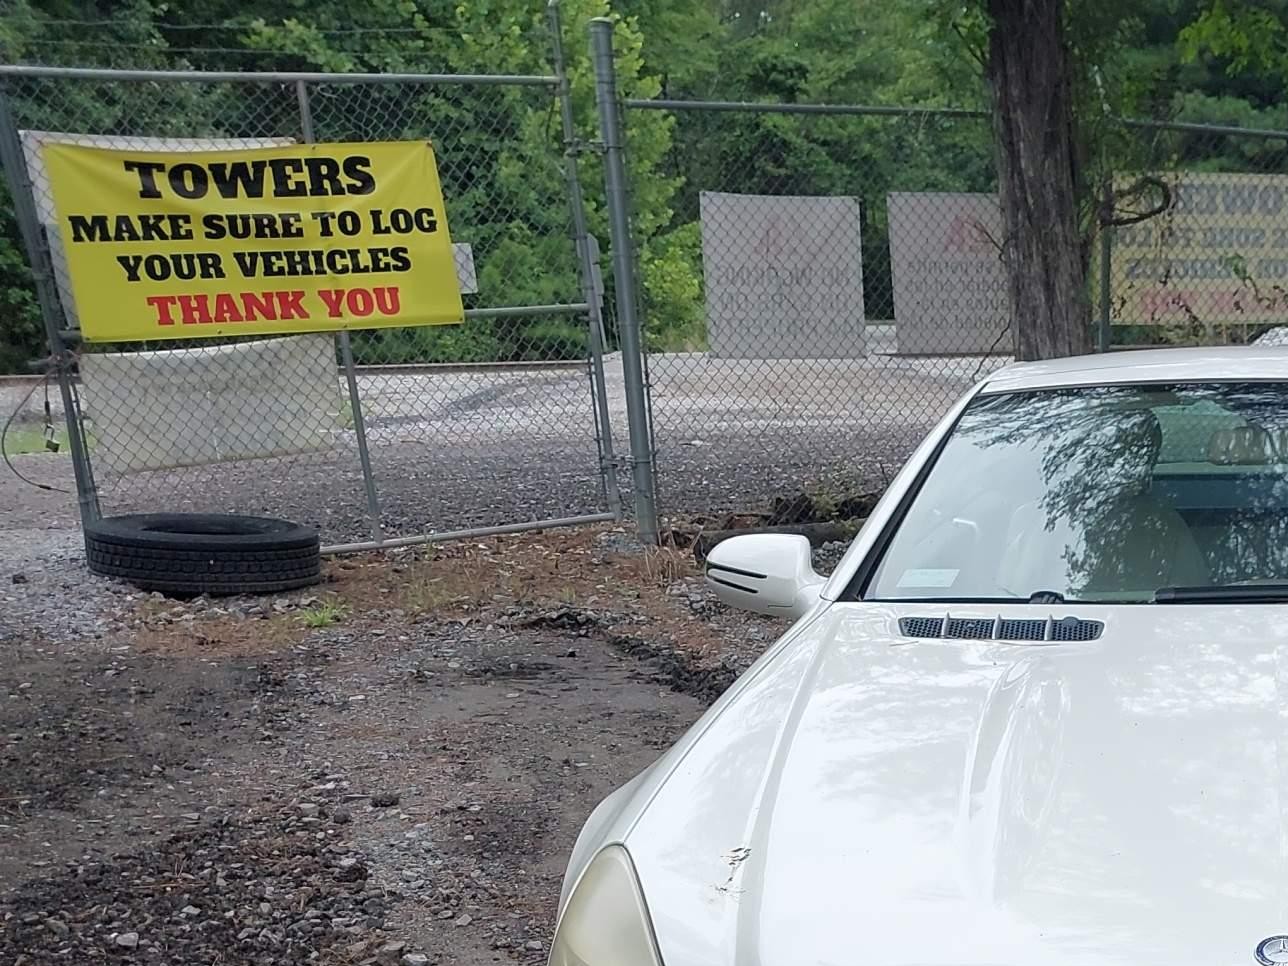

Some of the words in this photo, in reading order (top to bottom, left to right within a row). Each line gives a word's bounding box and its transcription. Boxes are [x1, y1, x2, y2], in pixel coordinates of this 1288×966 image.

[124, 156, 376, 199] TOWERS
[68, 214, 193, 242] MAKE
[204, 212, 304, 240] SURE
[312, 211, 361, 237] TO
[369, 207, 438, 234] LOG
[117, 251, 226, 282] YOUR
[233, 247, 412, 278] VEHICLES
[147, 290, 310, 326] THANK
[317, 287, 401, 318] YOU
